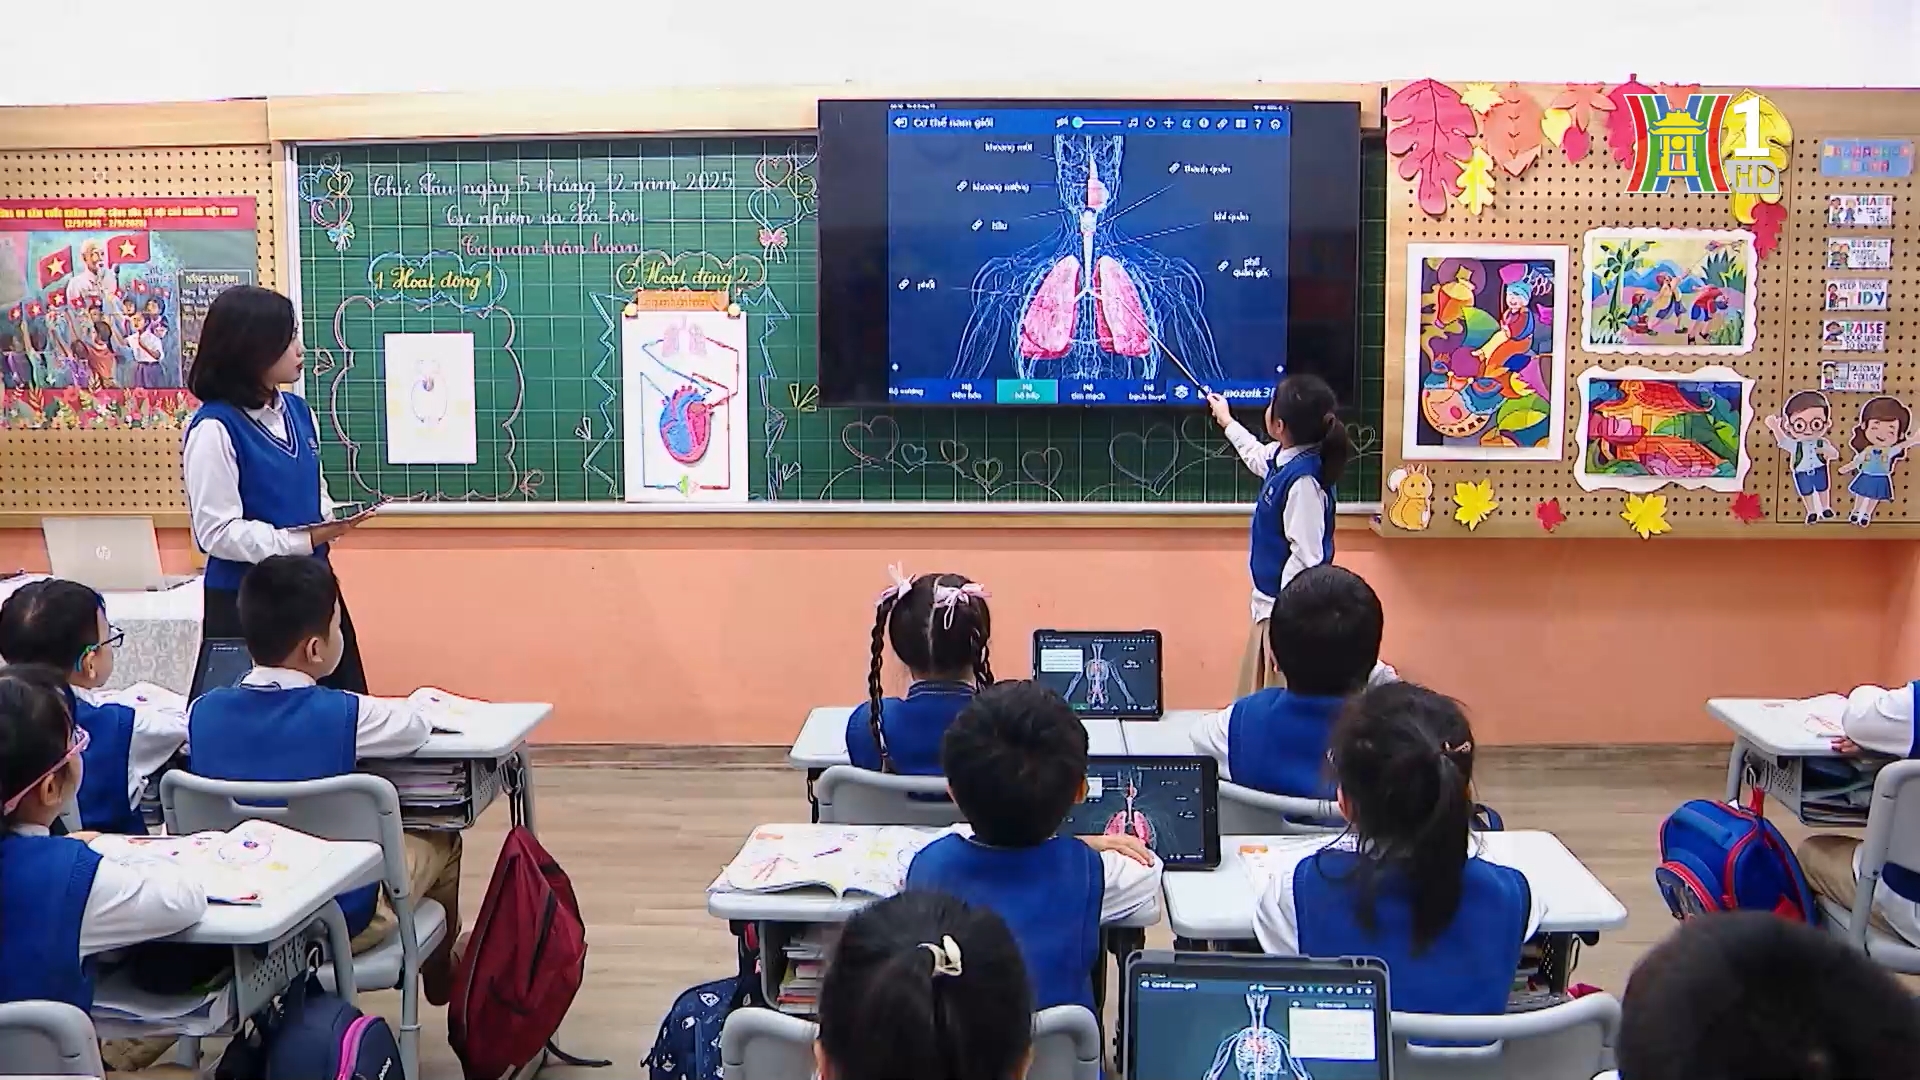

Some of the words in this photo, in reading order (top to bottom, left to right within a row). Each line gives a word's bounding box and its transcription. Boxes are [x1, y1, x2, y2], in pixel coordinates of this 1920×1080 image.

[373, 174, 412, 196] Thứ
[462, 178, 510, 207] ngày
[519, 174, 530, 193] 5
[538, 168, 596, 204] tháng
[632, 176, 681, 192] năm
[685, 171, 733, 191] 2025
[478, 202, 533, 226] nhiên
[541, 209, 566, 225] và
[608, 200, 640, 227] hội
[1847, 291, 1886, 306] TIDY
[1845, 323, 1884, 334] RAISE
